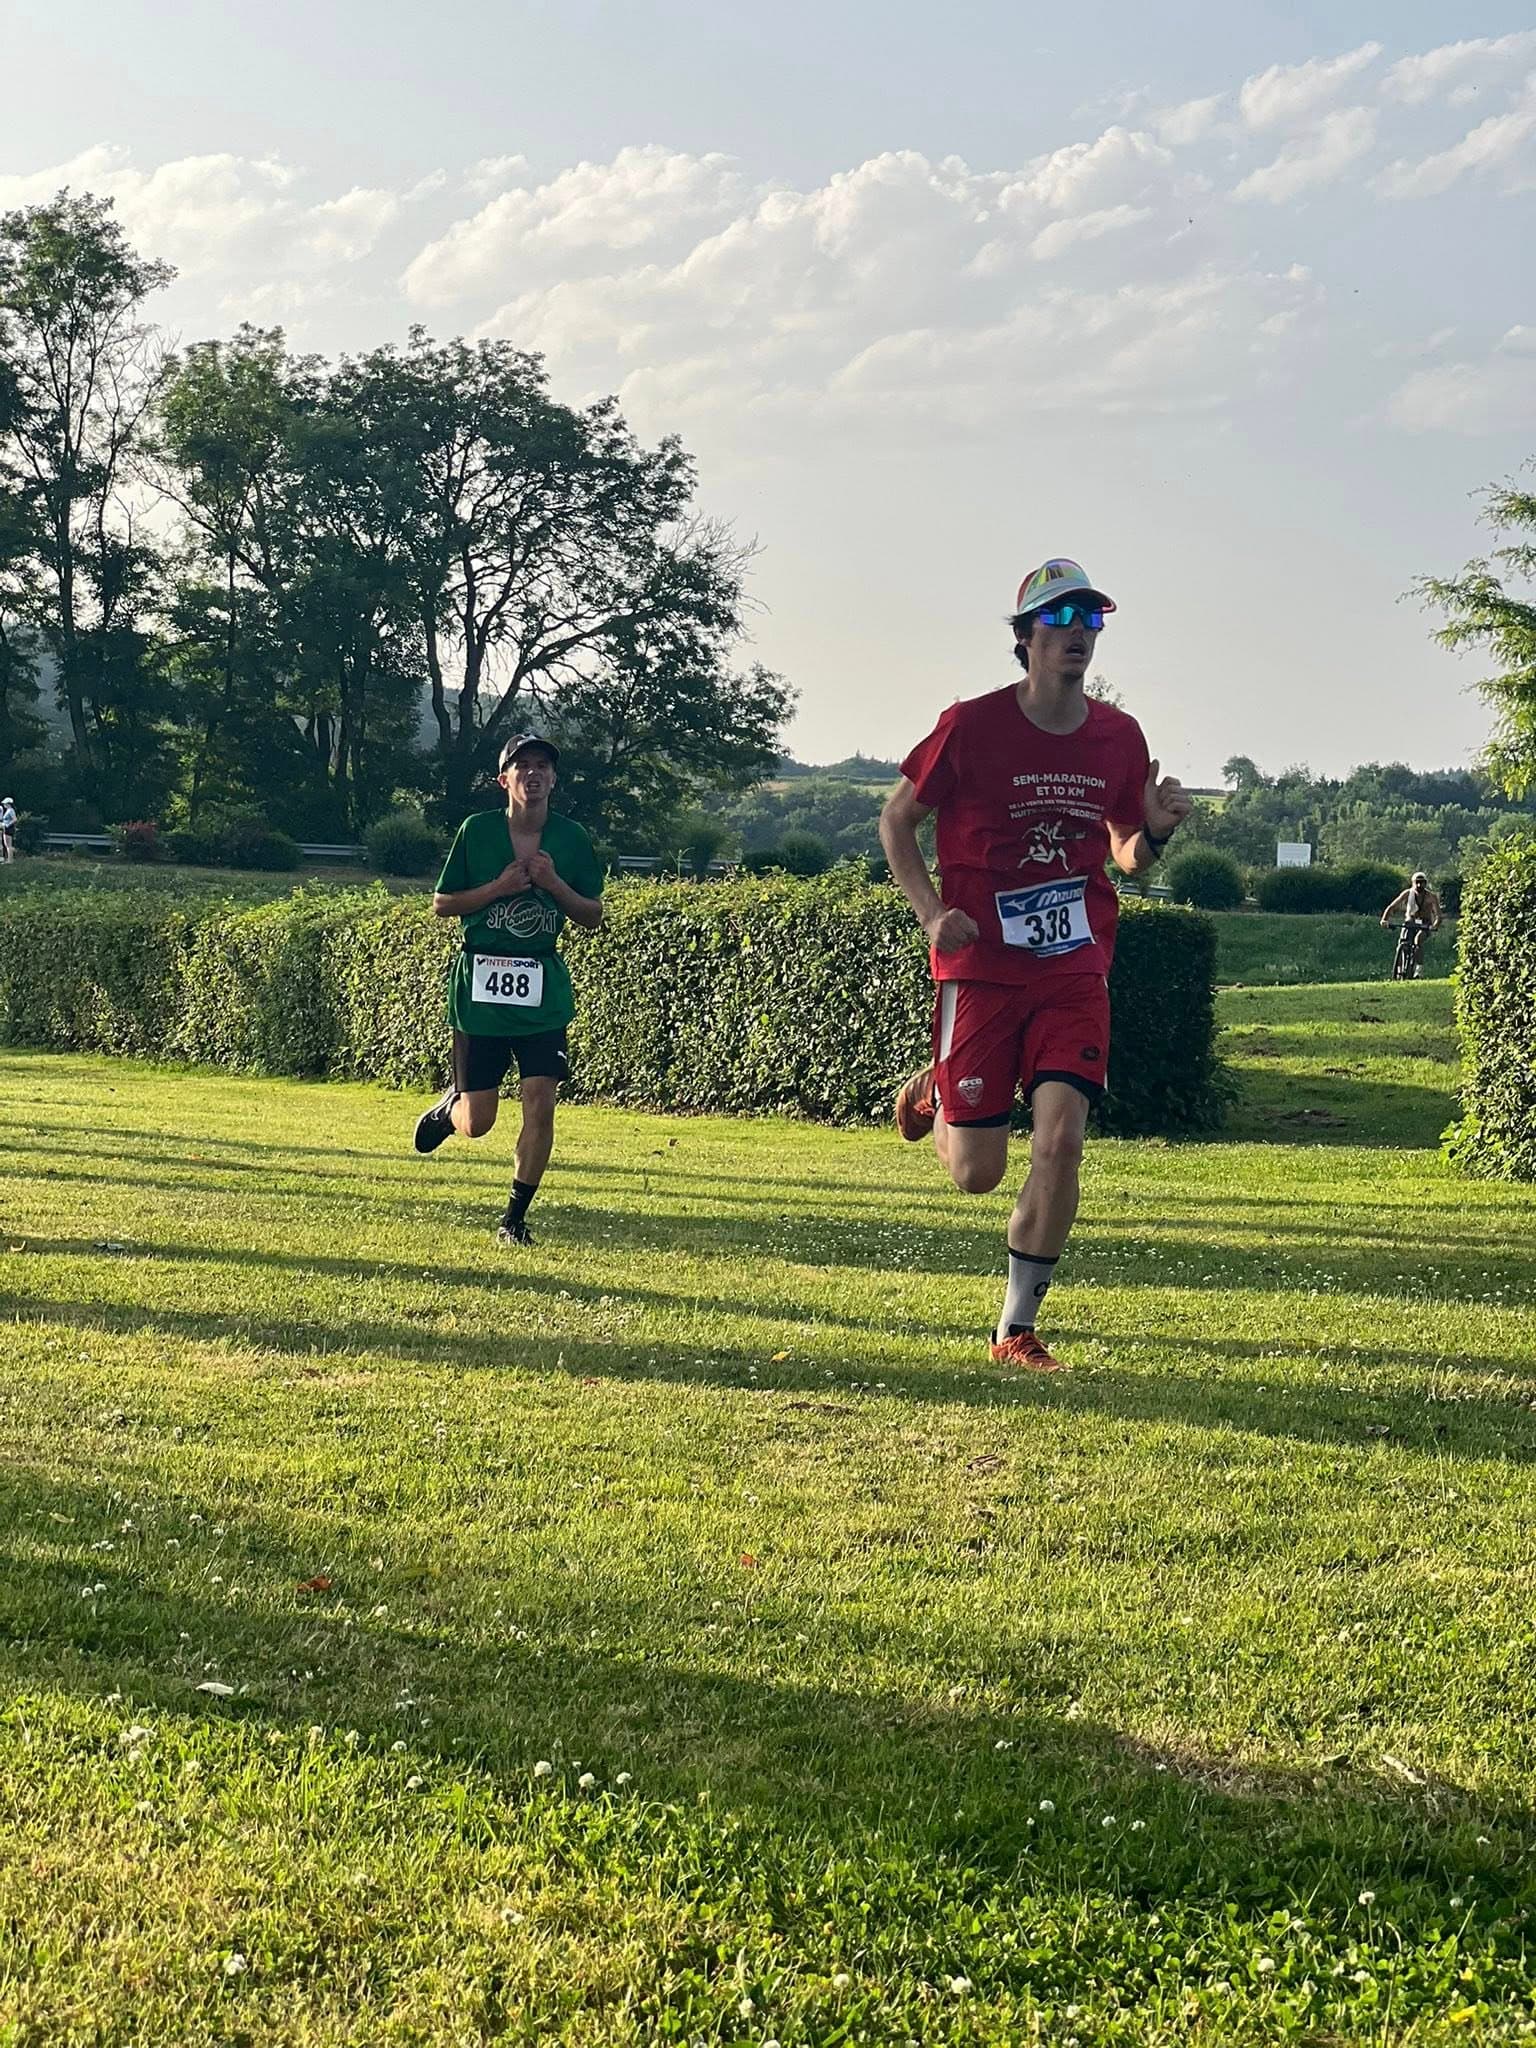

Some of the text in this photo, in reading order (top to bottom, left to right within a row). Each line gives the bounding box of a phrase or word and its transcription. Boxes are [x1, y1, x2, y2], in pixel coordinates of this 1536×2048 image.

[1012, 773, 1106, 789] SEMI-MARATHON
[1036, 786, 1086, 798] ET 10 KM
[1025, 906, 1072, 946] 338
[486, 958, 540, 969] INTERSPORT
[485, 972, 530, 998] 488
